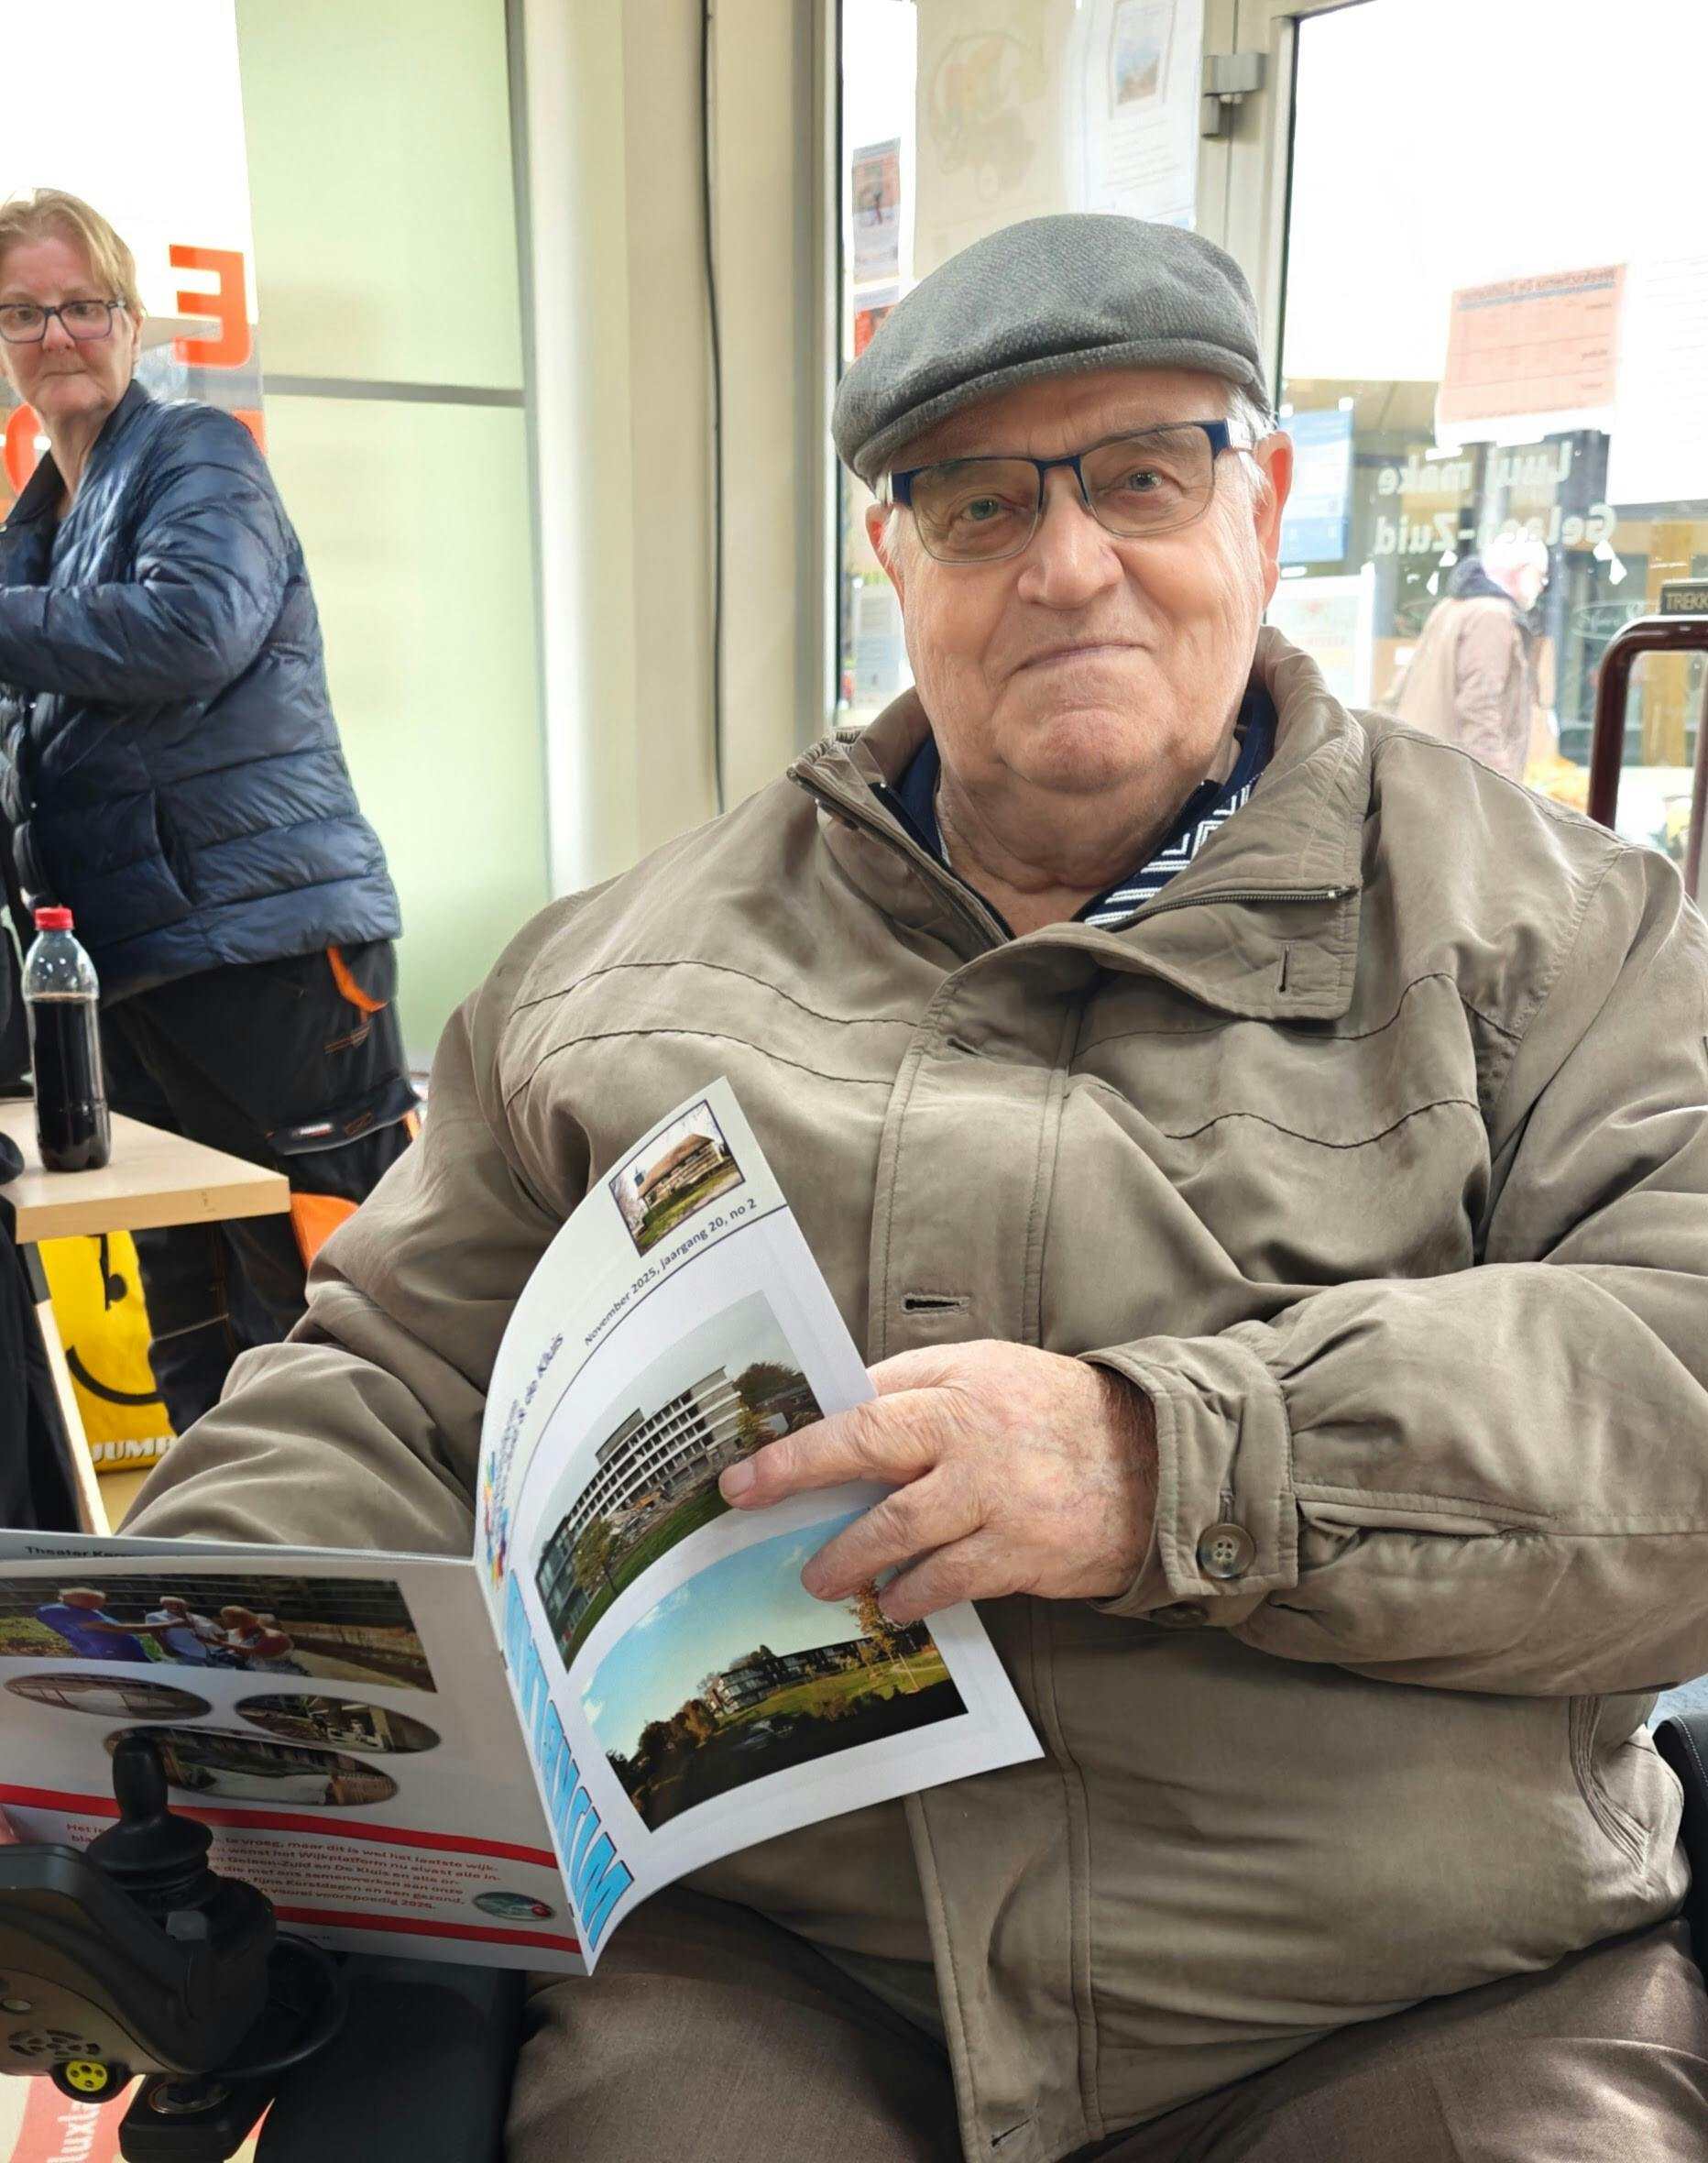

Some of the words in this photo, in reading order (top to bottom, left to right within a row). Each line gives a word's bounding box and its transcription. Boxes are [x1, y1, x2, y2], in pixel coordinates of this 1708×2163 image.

[585, 1290, 632, 1346] November
[630, 1267, 661, 1295] 2025,
[659, 1227, 709, 1270] jaargang
[707, 1215, 729, 1234] 20,
[728, 1204, 747, 1222] no
[747, 1196, 758, 1210] 2
